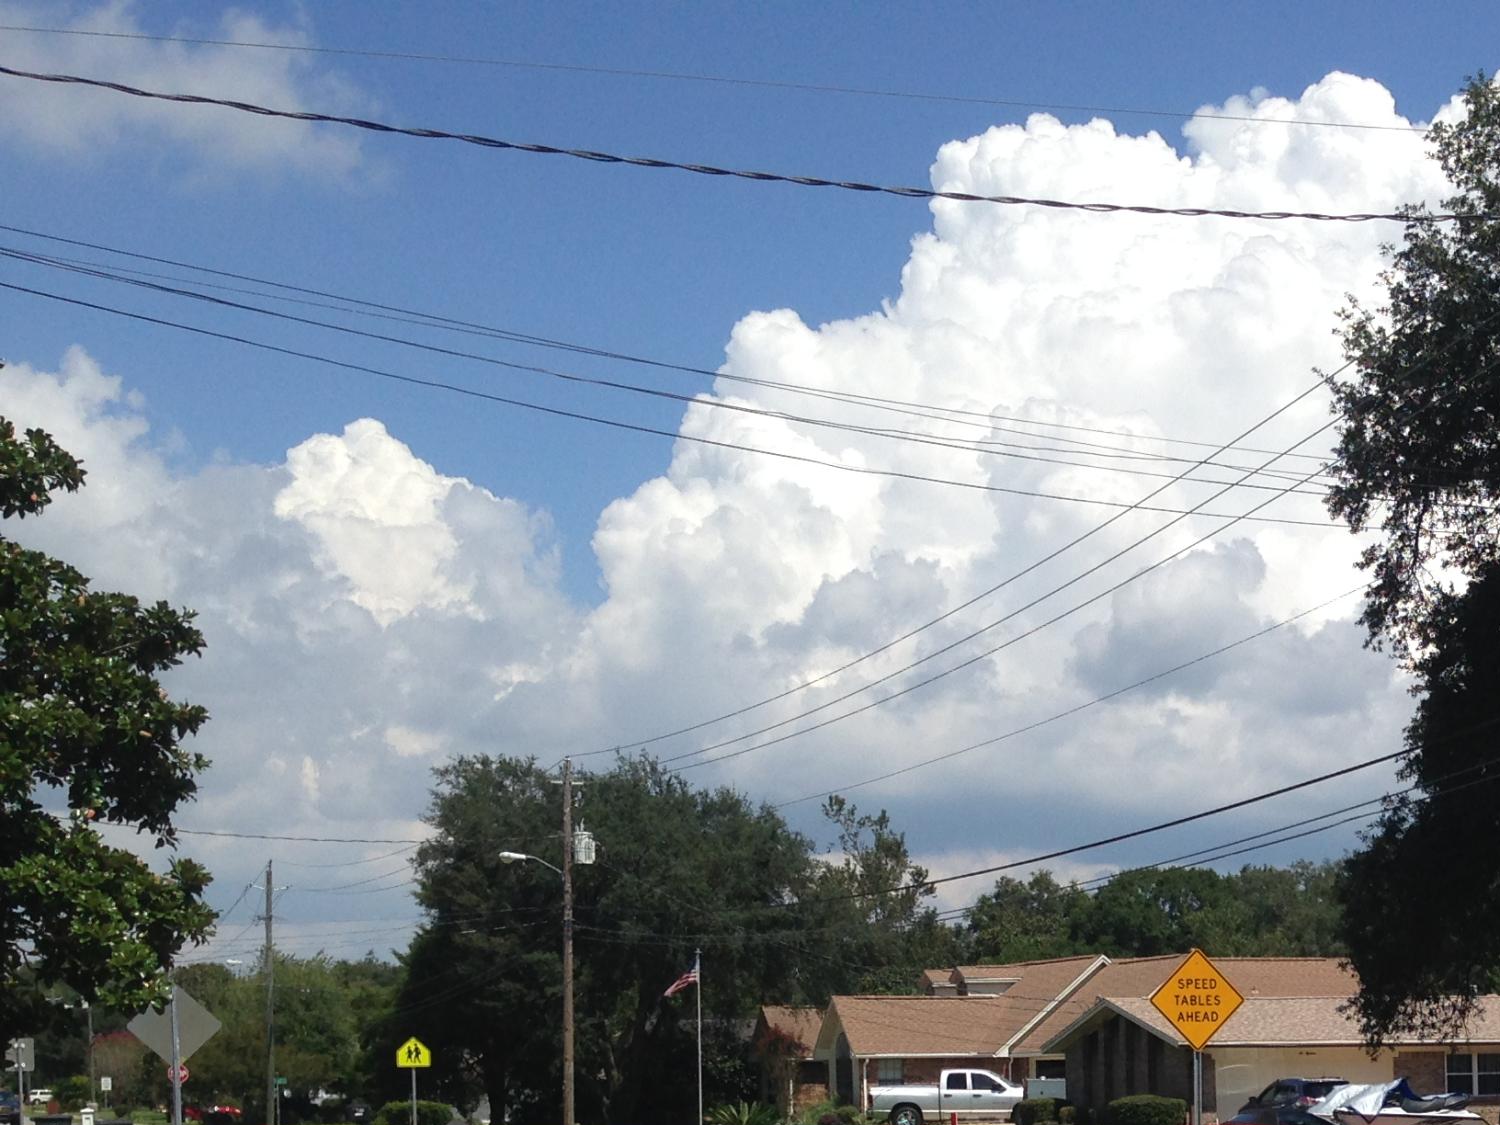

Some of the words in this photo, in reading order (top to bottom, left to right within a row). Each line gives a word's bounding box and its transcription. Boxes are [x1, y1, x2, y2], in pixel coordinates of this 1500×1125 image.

[1177, 978, 1217, 989] SPEED
[1174, 994, 1221, 1006] TABLES
[1177, 1011, 1219, 1022] AHEAD
